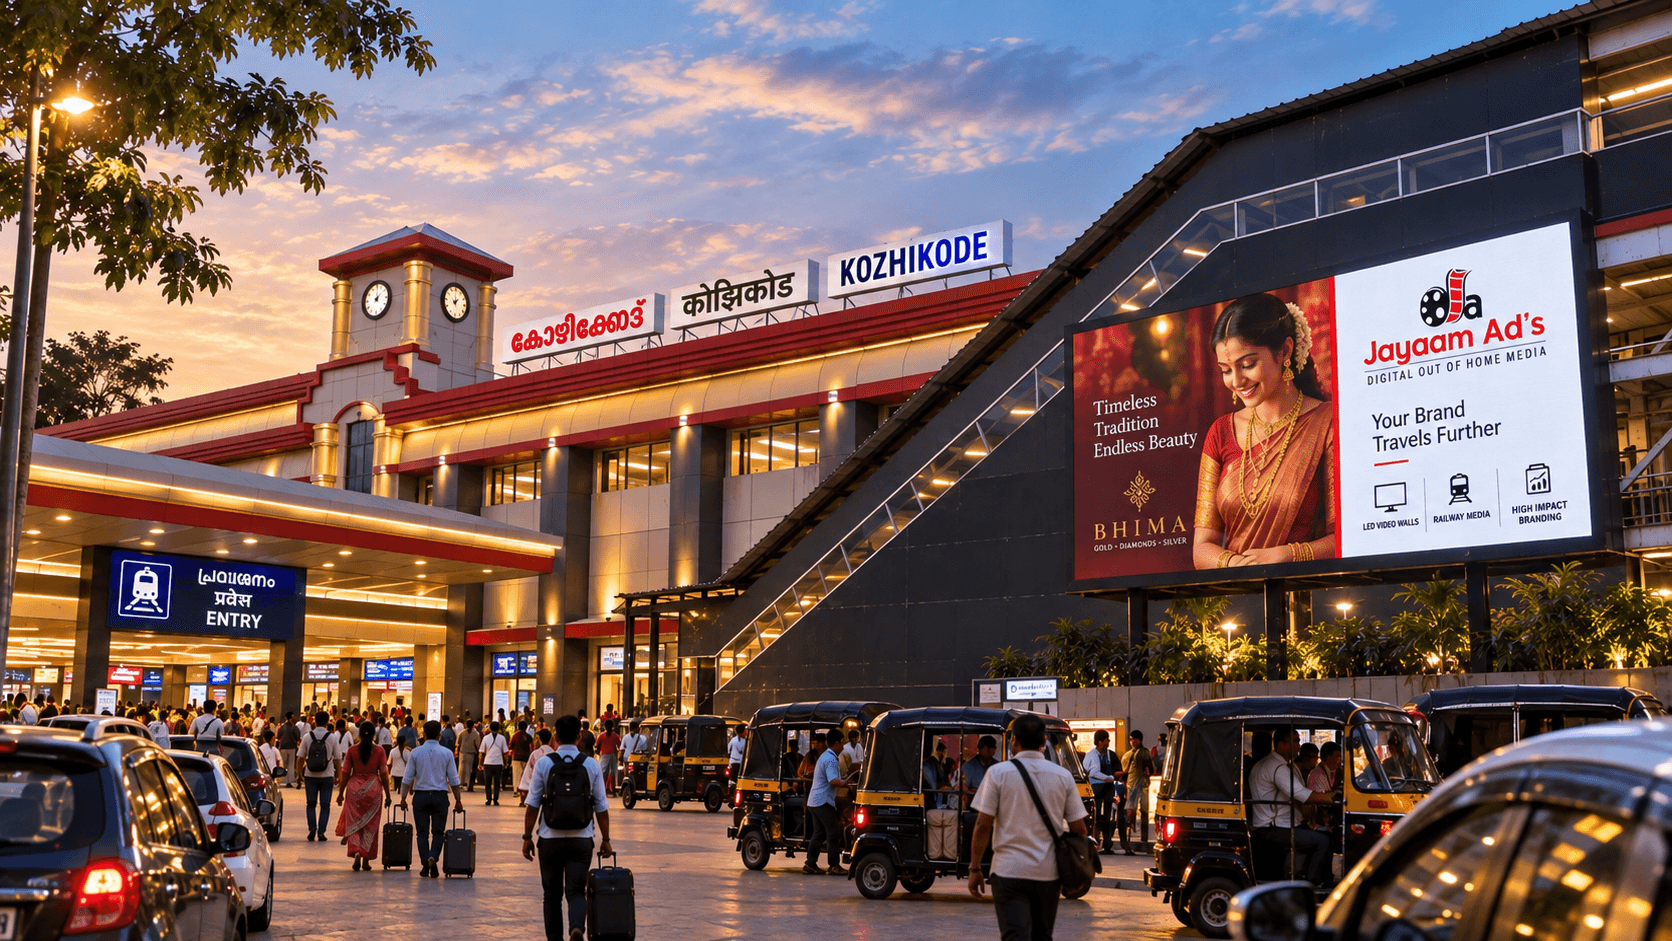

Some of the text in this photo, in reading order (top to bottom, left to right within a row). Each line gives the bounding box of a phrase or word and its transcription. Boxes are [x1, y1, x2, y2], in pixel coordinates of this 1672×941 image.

[839, 231, 988, 286] KOZHIKODE
[681, 269, 795, 317] कोझिकोड
[1364, 312, 1545, 365] Jayaam Ad's
[1367, 346, 1547, 386] DIGITAL OUT OF HOME MEDIA
[1093, 394, 1157, 416] Timeless
[1372, 400, 1465, 430] Your Brand
[1094, 416, 1158, 437] Tradition
[1373, 420, 1502, 452] Travels Further
[1094, 432, 1197, 458] Endless Beauty
[1433, 510, 1490, 524] RAILWAY MEDIA
[1512, 500, 1568, 514] HIGH IMPACT
[1518, 512, 1562, 525] BRANDING
[1095, 516, 1187, 540] BHIMA
[1362, 517, 1420, 531] LED VIDEO WALLS
[1093, 537, 1187, 552] GOLD DIAMONDS SILVER
[206, 610, 262, 629] ENTRY
